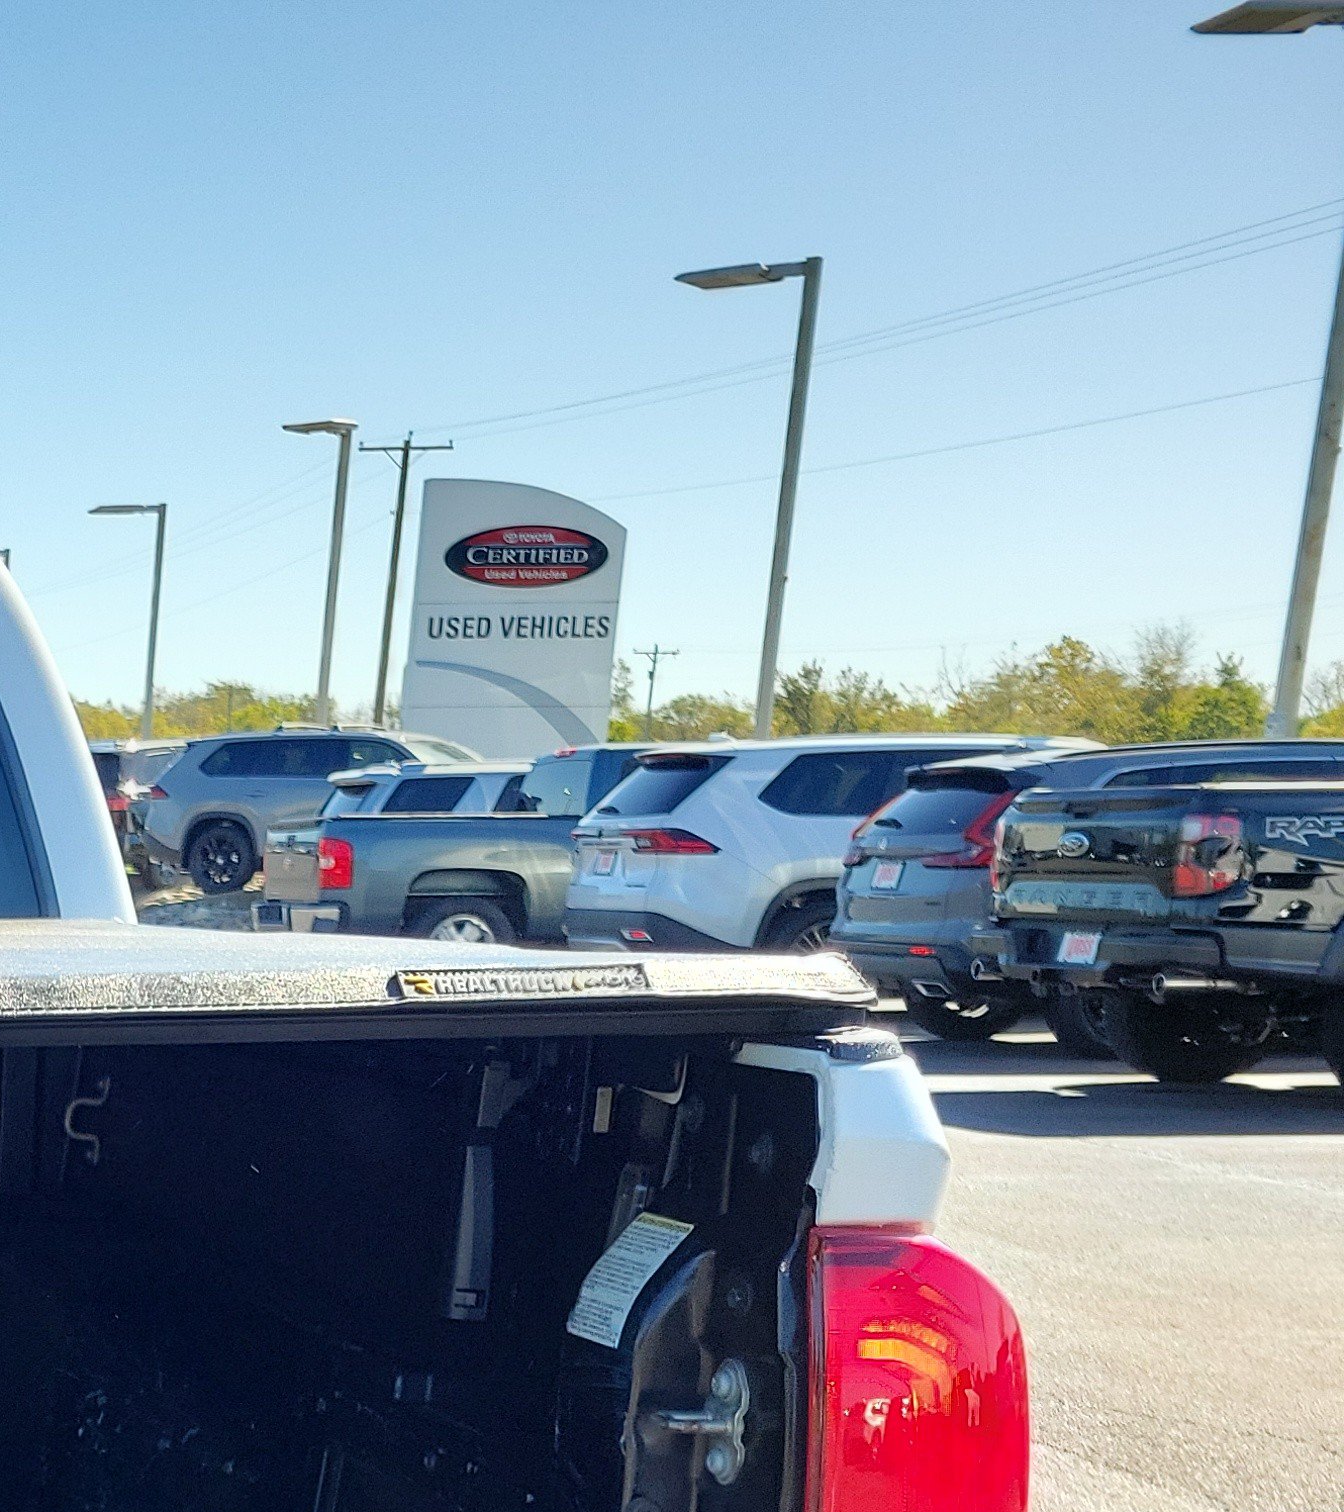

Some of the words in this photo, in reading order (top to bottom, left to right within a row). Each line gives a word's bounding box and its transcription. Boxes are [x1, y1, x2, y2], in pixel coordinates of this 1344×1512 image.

[466, 546, 589, 565] CERTIFIED
[484, 569, 517, 580] Used
[519, 568, 569, 580] Vehicles
[428, 616, 492, 639] USED
[500, 615, 611, 639] VEHICLES
[434, 970, 573, 994] REALTRUCK
